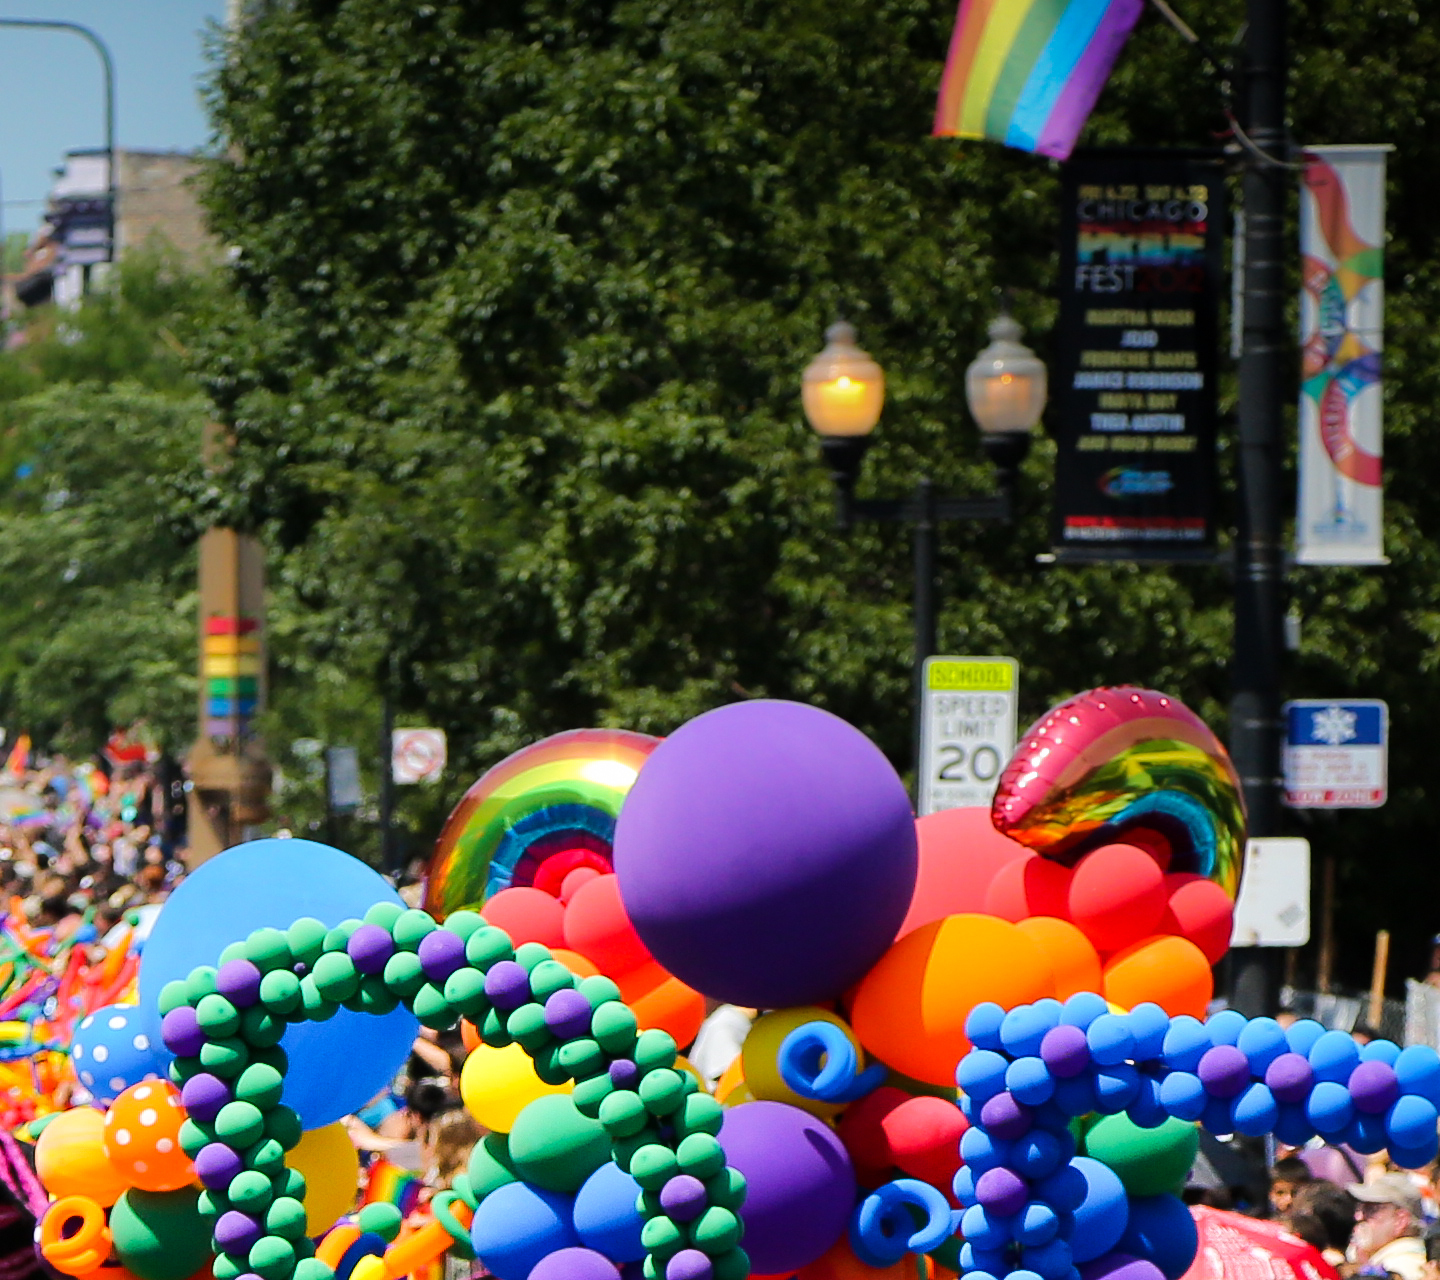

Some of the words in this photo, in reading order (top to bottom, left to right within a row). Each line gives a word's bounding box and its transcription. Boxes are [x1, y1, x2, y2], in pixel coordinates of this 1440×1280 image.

[1077, 200, 1208, 222] CHICAGO
[1075, 265, 1135, 292] FEST
[934, 695, 1009, 717] SPEED
[940, 720, 997, 738] LIMIT
[938, 743, 1002, 782] 20
